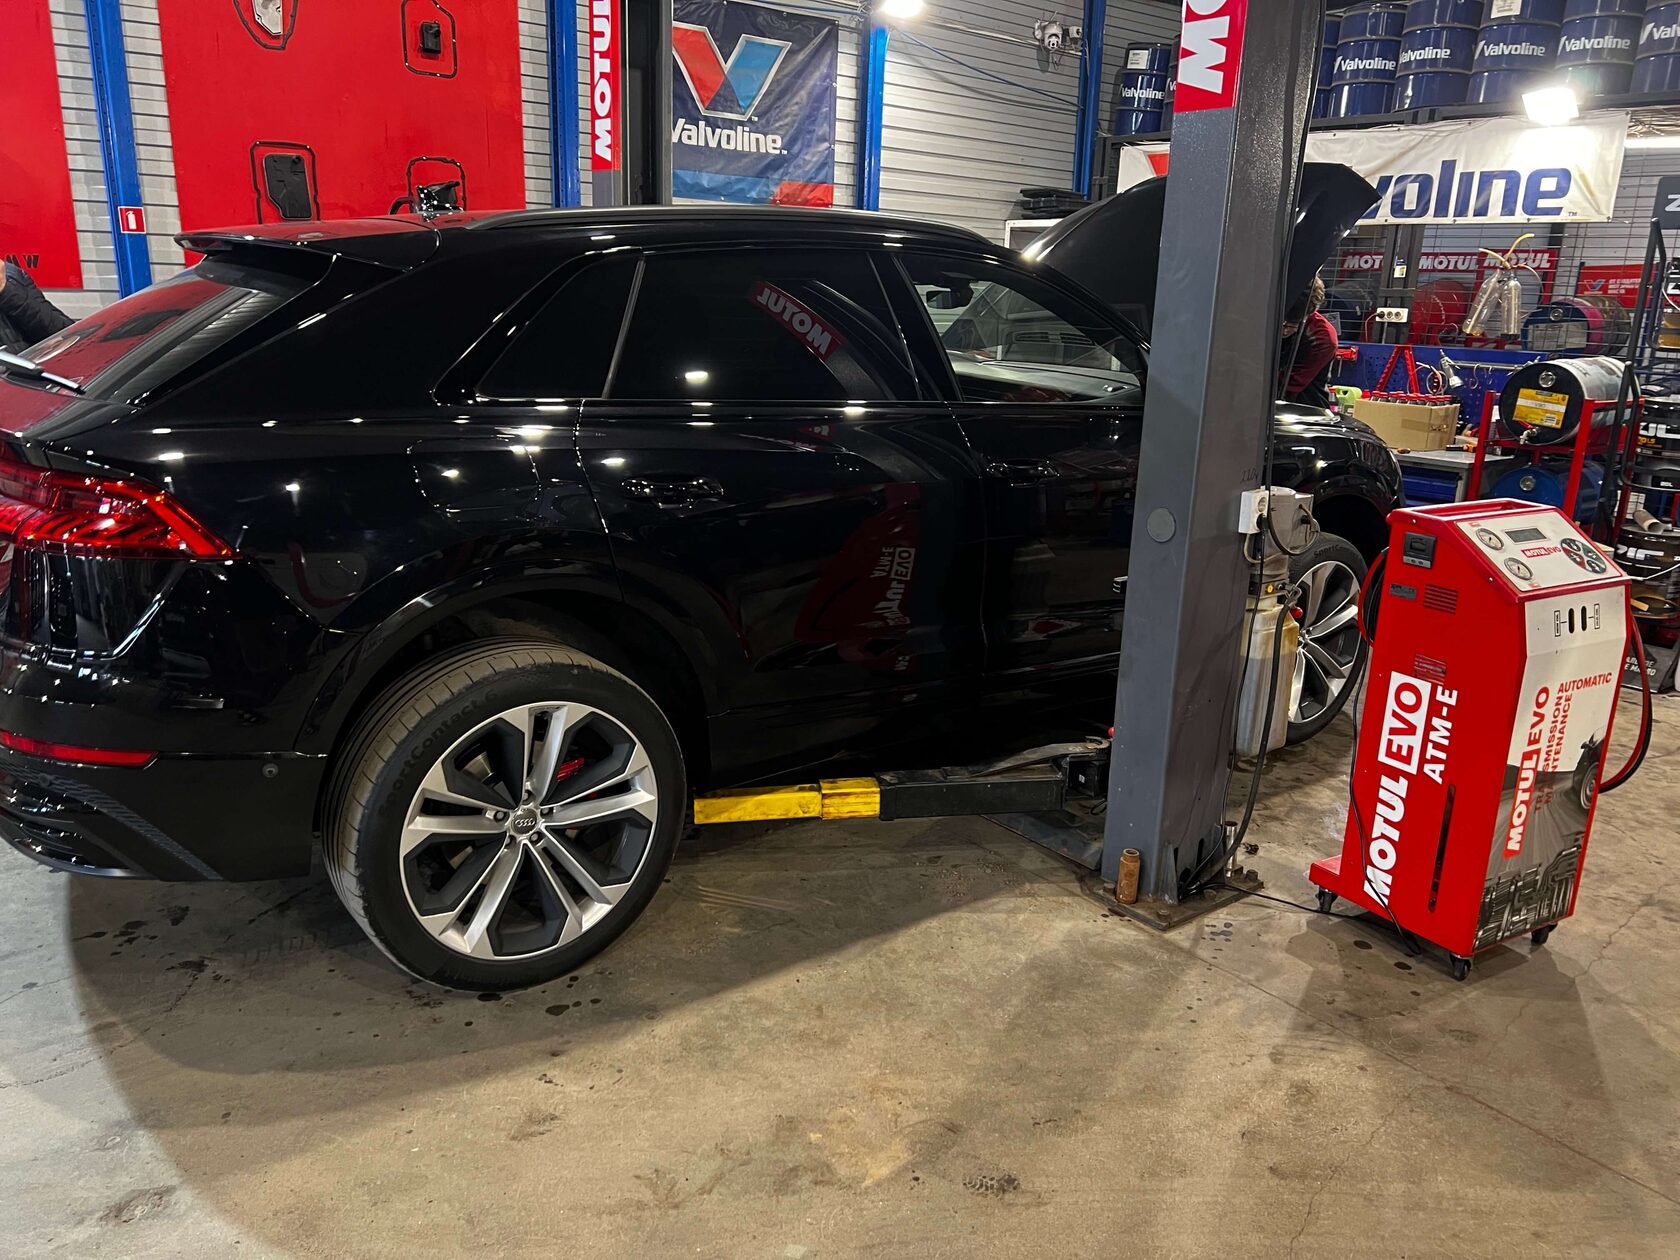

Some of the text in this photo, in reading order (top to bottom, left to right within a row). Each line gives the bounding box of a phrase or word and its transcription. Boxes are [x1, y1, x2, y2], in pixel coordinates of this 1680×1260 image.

[1483, 42, 1546, 57] Valvoline
[1565, 36, 1631, 52] Valvoline
[1341, 58, 1397, 71] Valvoline
[1121, 86, 1165, 99] Valvoline
[672, 118, 782, 155] Valvoline
[1344, 255, 1384, 269] MOT
[1557, 672, 1612, 695] AUTOMATIC
[1423, 685, 1458, 784] ATM-E
[1507, 686, 1550, 851] MOTUL EVO
[1363, 682, 1423, 908] MOTUL EVO
